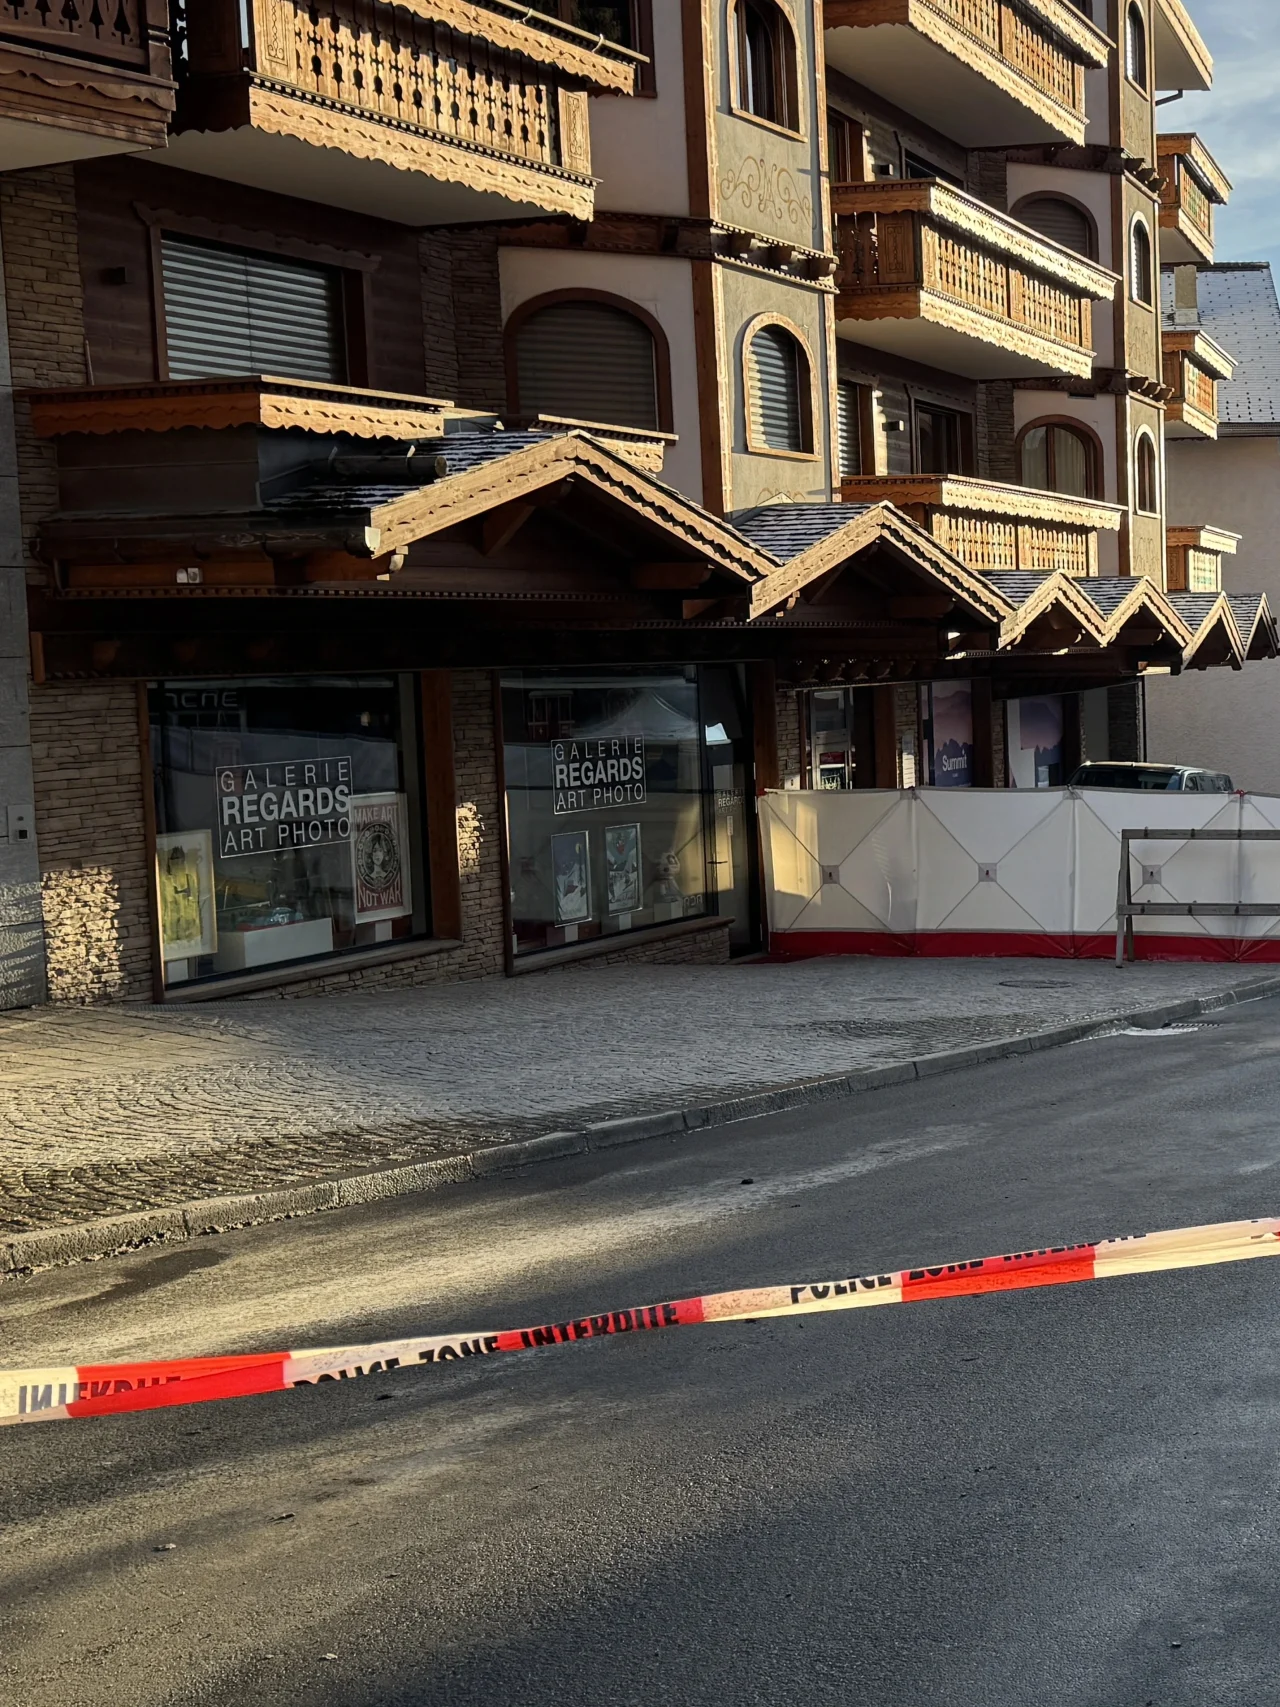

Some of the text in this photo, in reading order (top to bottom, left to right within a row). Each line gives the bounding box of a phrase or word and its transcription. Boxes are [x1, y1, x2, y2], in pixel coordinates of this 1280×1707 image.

[555, 736, 642, 761] GALERIE
[942, 750, 968, 772] Summit
[220, 761, 349, 793] GALERIE
[555, 756, 644, 789] REGARDS
[222, 784, 350, 826] REGARDS
[556, 783, 644, 810] ART PHOTO
[354, 804, 399, 831] MAKE ART
[224, 817, 351, 853] ART PHOTO
[357, 872, 402, 908] NOT WAR
